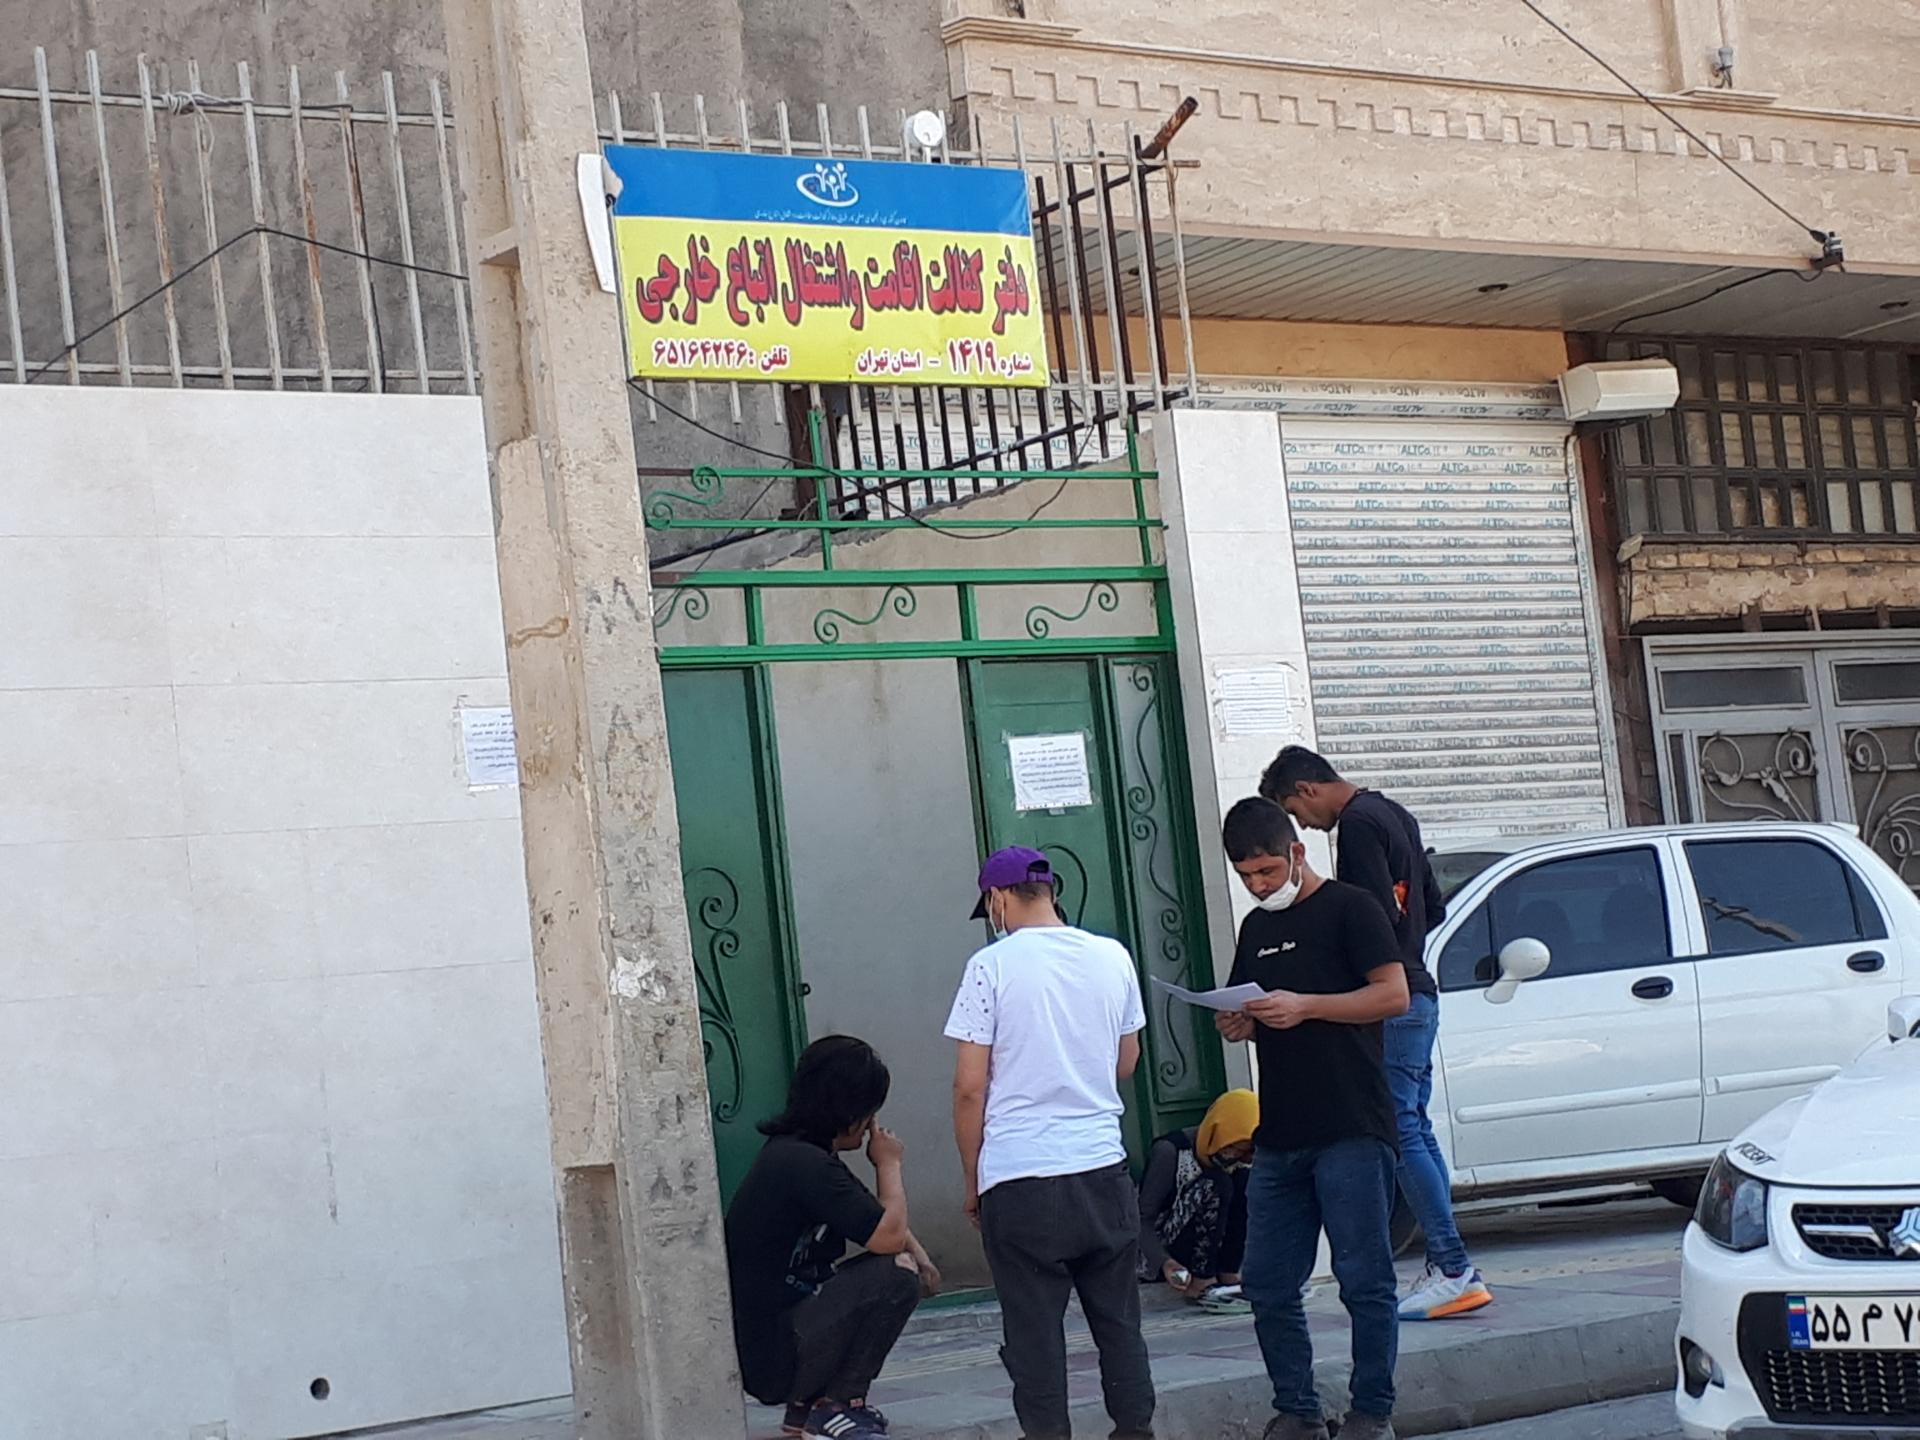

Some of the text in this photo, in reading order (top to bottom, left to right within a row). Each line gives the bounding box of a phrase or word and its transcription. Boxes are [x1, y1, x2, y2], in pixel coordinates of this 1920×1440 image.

[636, 234, 720, 325] خارجی
[726, 236, 777, 327] اتباع
[864, 240, 923, 312] اقامت
[926, 243, 983, 315] کفالت
[992, 245, 1029, 335] دفتر
[858, 349, 888, 373] تهران
[892, 351, 921, 373] استان
[949, 340, 996, 372] ۱۴۱۹
[1000, 353, 1031, 376] شماره
[1812, 1302, 1920, 1342] ۵۵ م ۷
